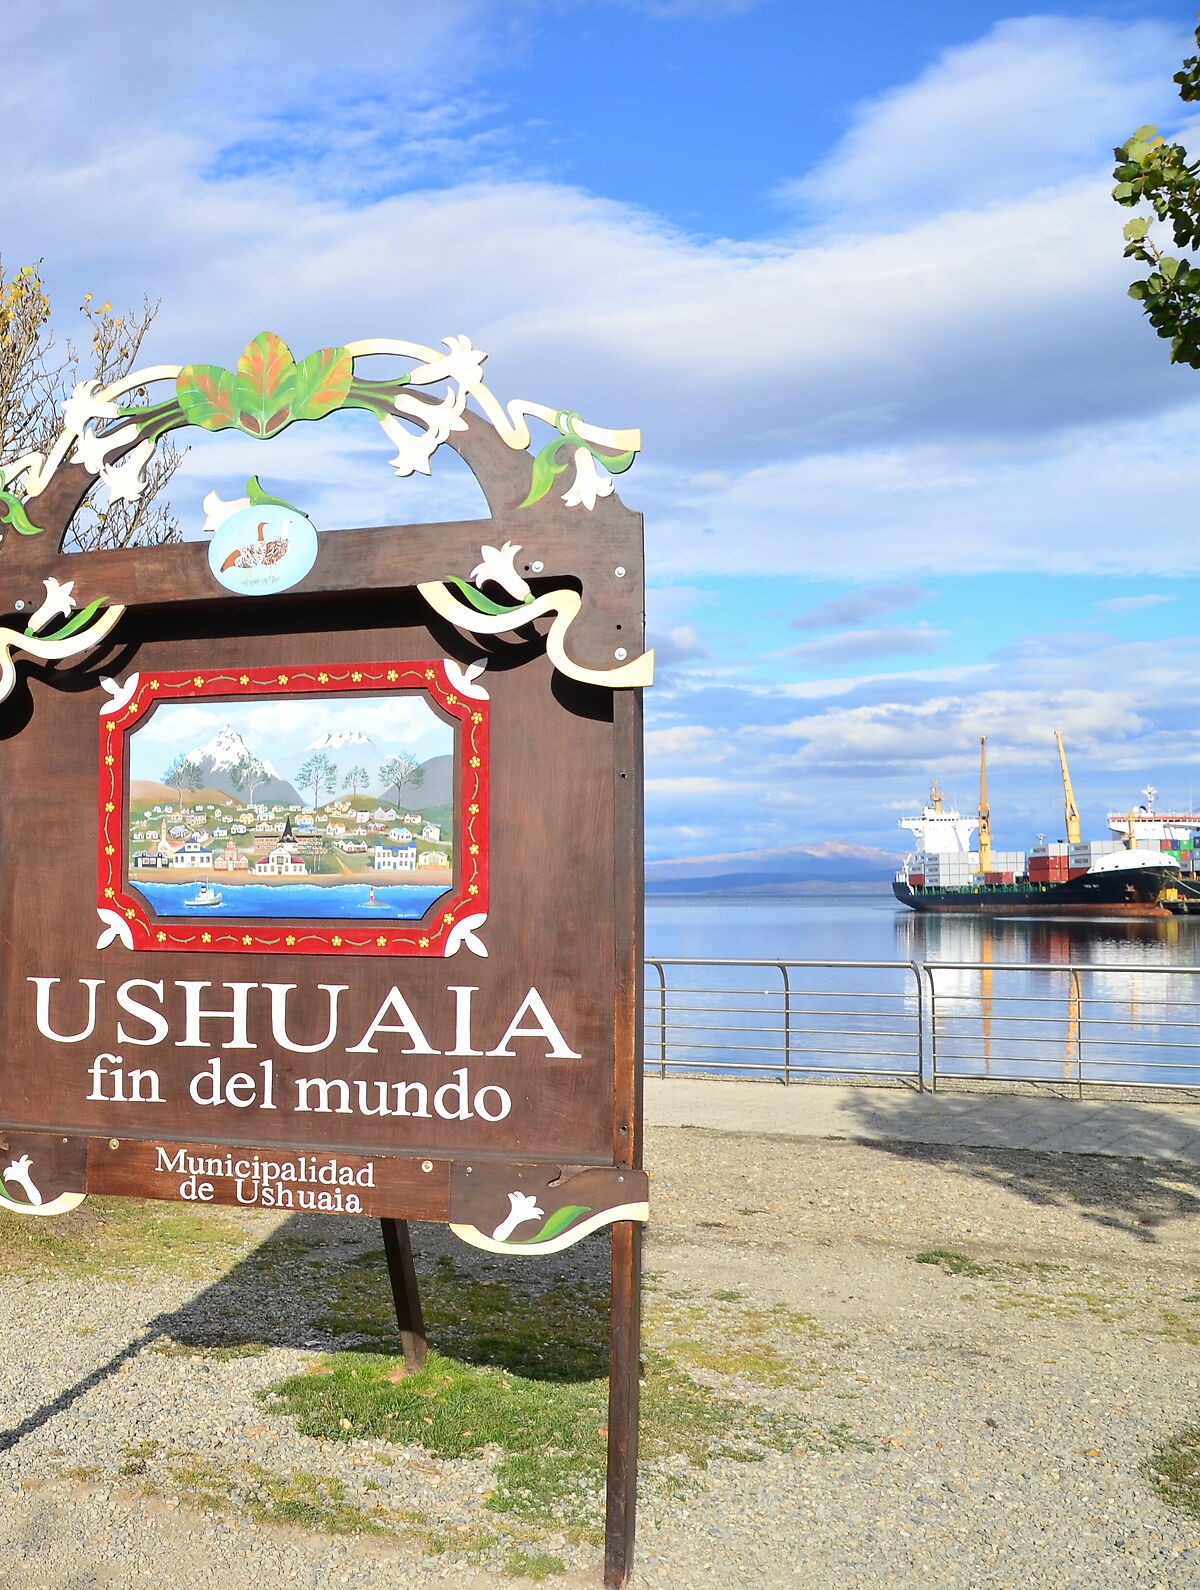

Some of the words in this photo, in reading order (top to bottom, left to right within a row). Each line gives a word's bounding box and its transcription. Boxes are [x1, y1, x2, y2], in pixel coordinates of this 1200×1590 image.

[26, 976, 583, 1059] USHUAIA
[86, 1052, 167, 1103] fin
[189, 1056, 277, 1110] del
[293, 1067, 513, 1122] mundo
[154, 1146, 376, 1188] Municipalidad
[179, 1174, 215, 1201] de
[233, 1178, 364, 1214] Ushuaia
